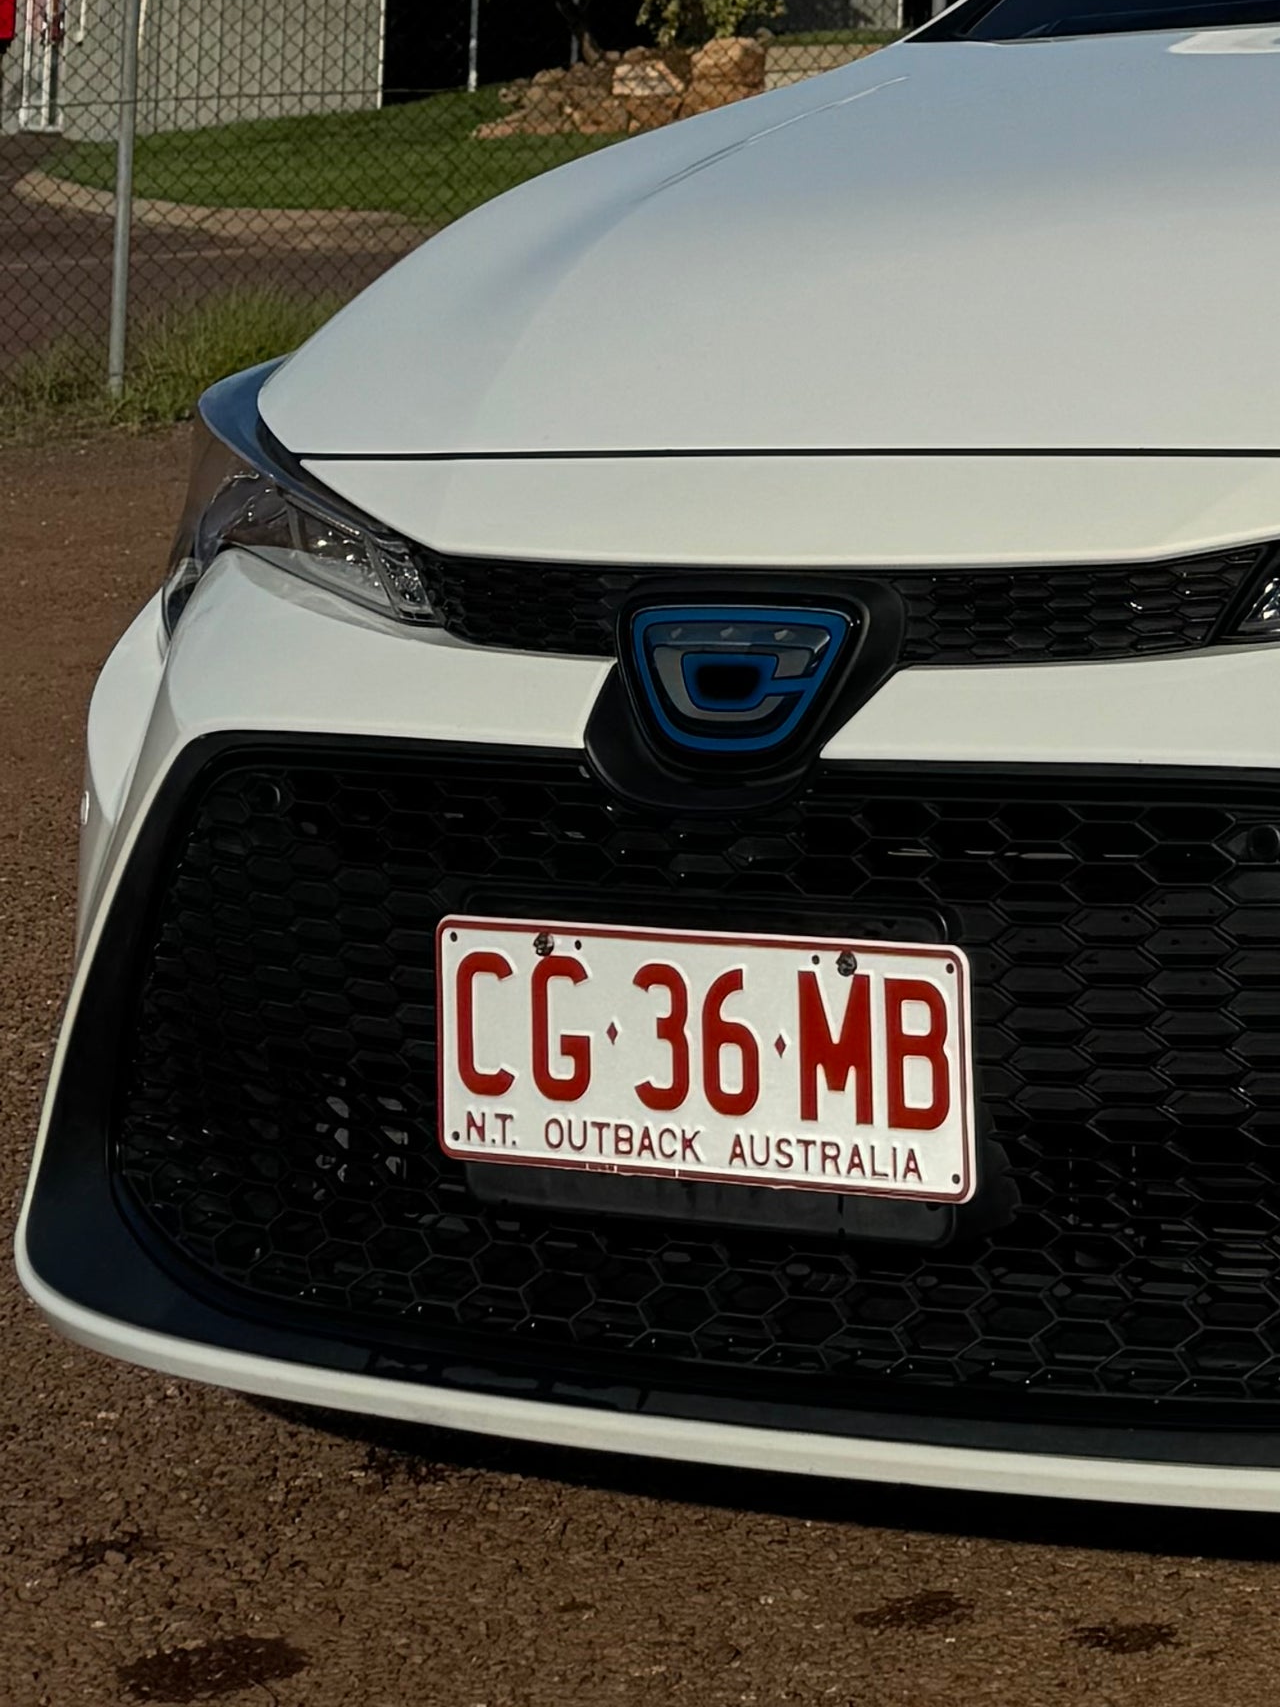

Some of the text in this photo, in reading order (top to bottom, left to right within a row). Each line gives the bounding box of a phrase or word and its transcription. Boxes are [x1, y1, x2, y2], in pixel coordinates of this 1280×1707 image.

[465, 1111, 924, 1184] N.T. OUTBACK AUSTRALIA
